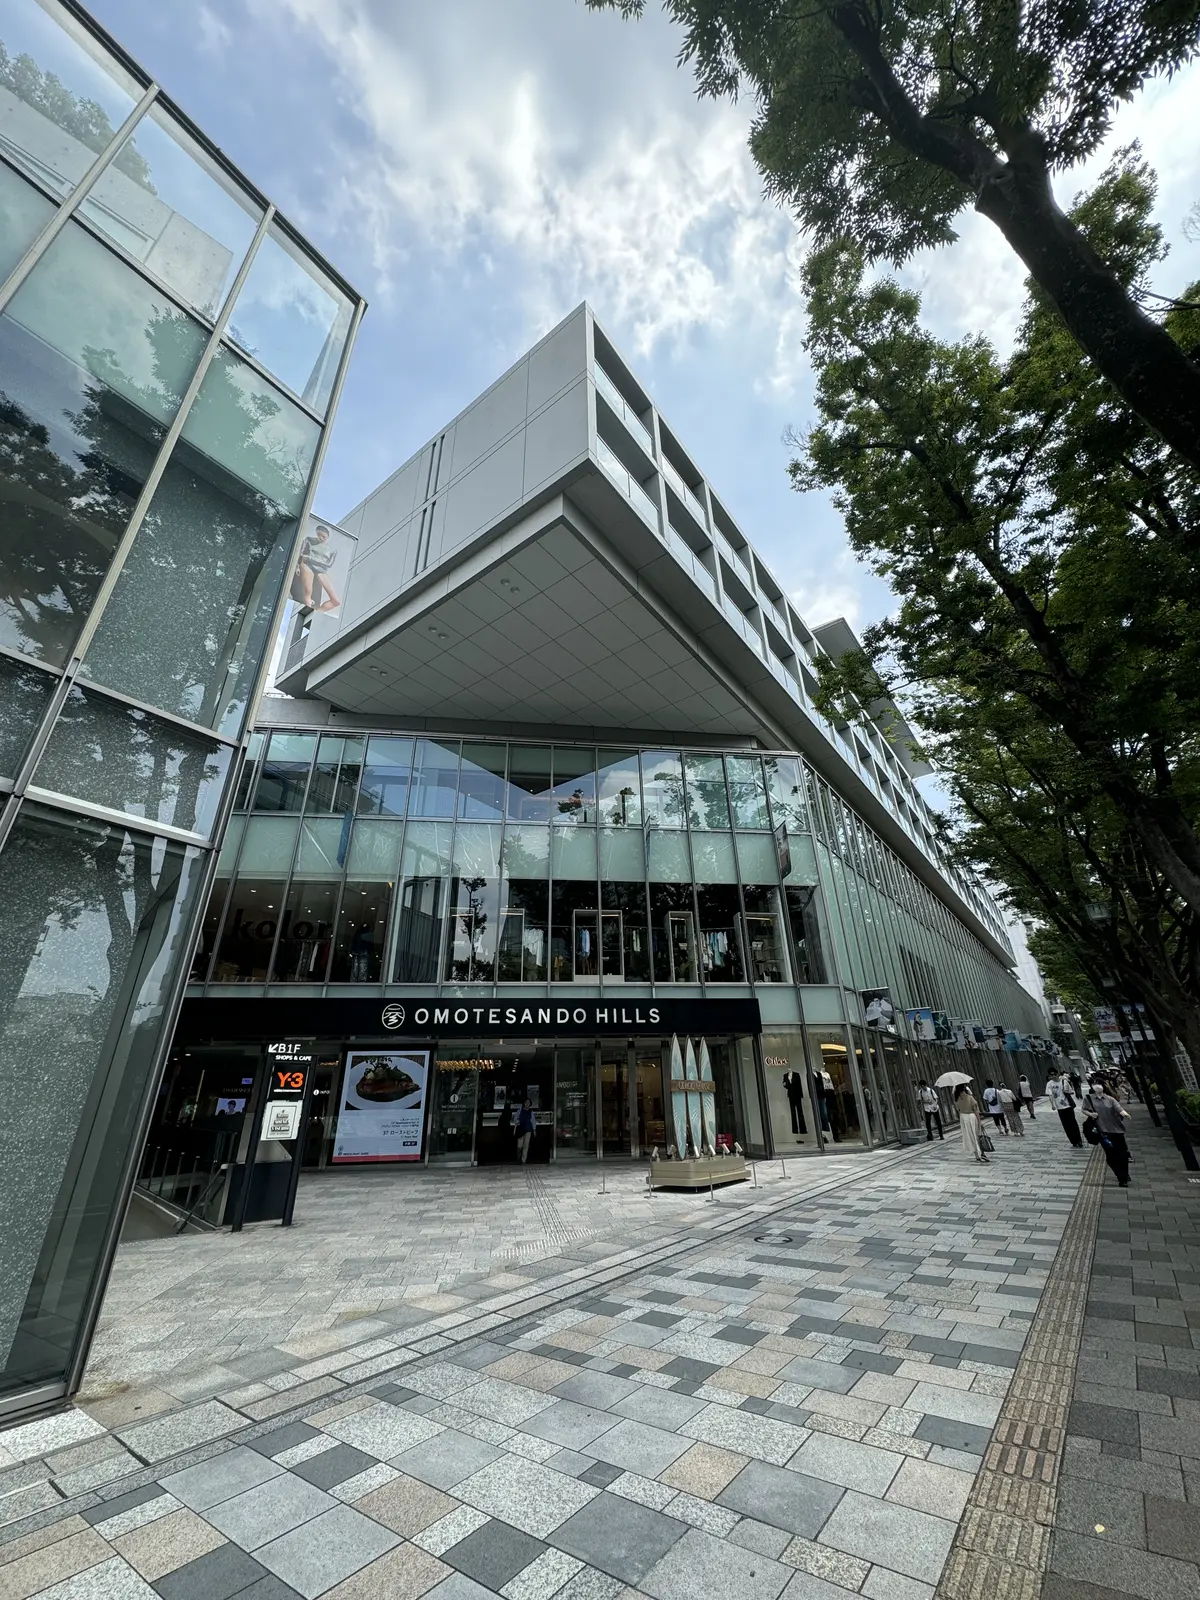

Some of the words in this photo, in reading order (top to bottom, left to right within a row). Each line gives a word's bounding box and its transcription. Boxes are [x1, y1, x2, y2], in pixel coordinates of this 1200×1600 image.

[233, 908, 332, 939] kolor
[415, 1008, 586, 1024] OMOTESANDO
[596, 1008, 660, 1024] HILLS
[278, 1043, 301, 1053] B1F
